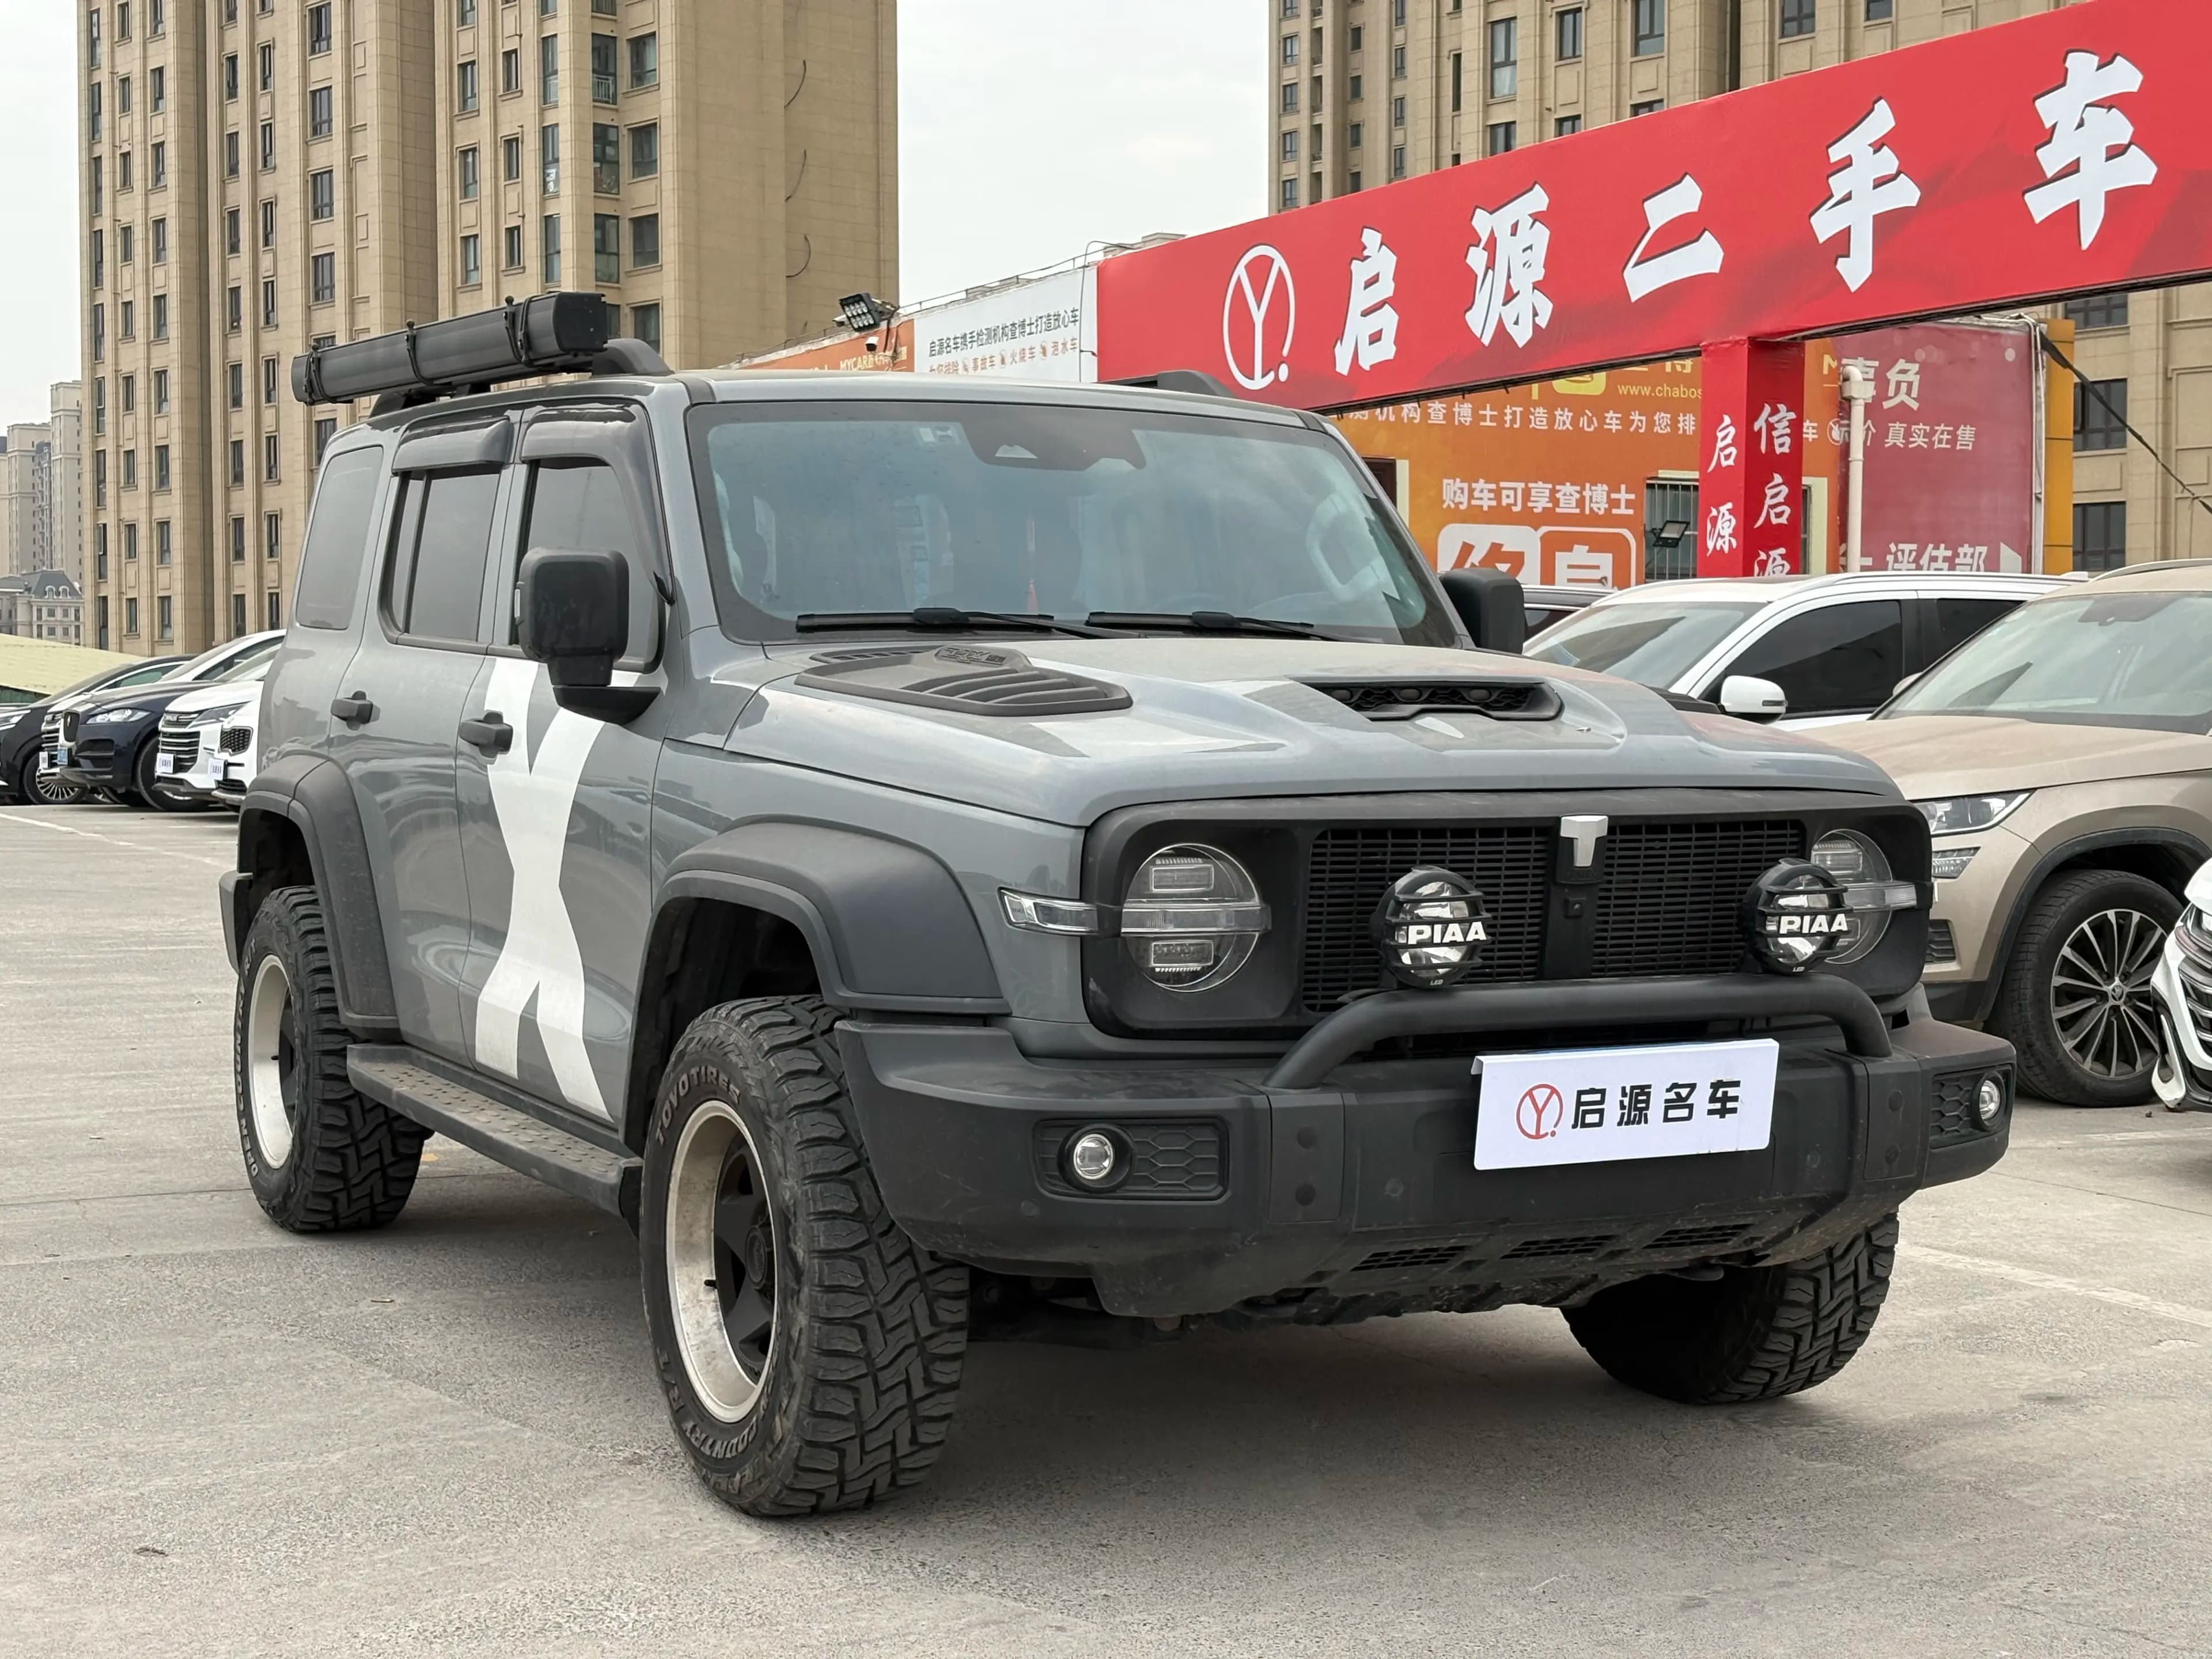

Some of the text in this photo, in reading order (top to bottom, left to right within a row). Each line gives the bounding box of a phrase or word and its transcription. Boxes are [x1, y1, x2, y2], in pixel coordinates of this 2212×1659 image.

[1334, 48, 2158, 376] 启源二手车
[1885, 421, 1976, 450] 真实在售
[1442, 478, 1636, 515] 购车可享查博士
[1707, 414, 1737, 557] 启源
[1408, 921, 1487, 945] PIAA
[1779, 914, 1849, 934] PIAA
[656, 1066, 741, 1146] TOYO TIRES
[1571, 1079, 1741, 1130] 启源名车
